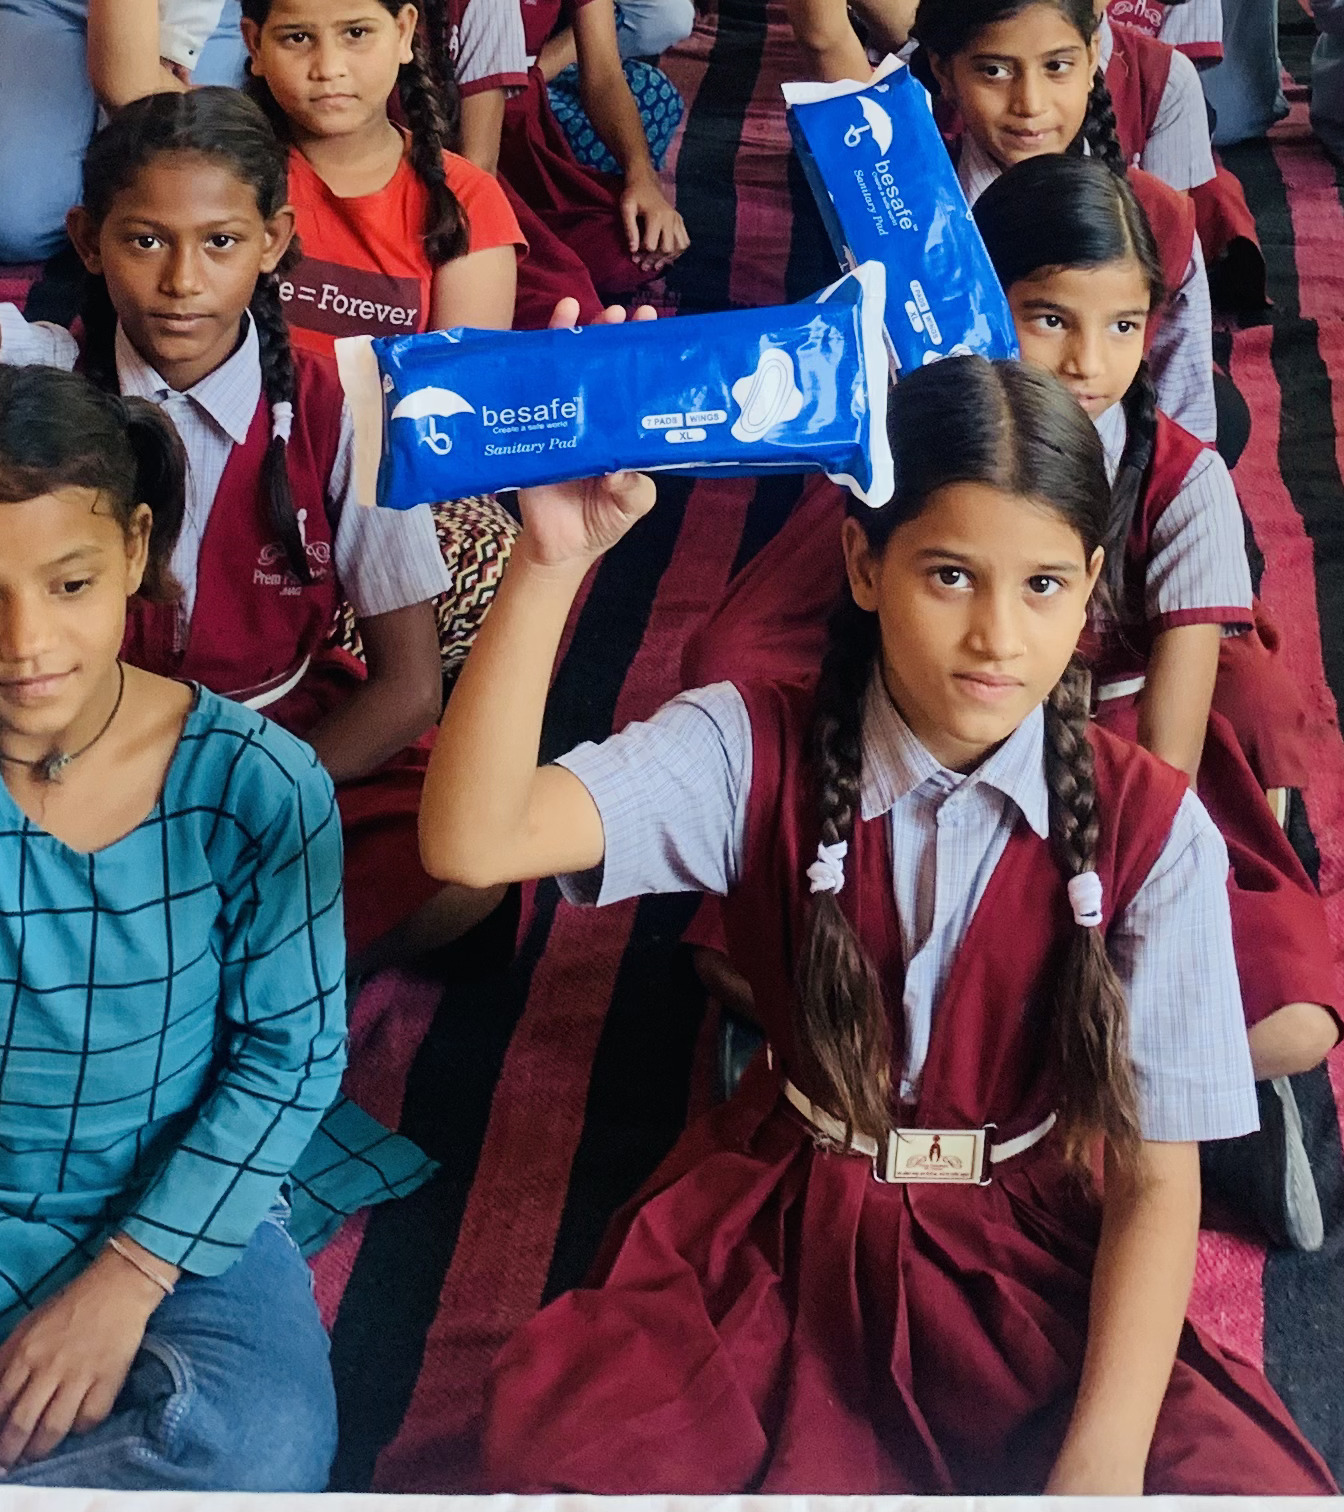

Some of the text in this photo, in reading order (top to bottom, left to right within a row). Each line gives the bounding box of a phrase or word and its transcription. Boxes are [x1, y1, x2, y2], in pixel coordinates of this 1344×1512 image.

[872, 215, 889, 236] Pad
[652, 416, 678, 426] PADS
[689, 413, 719, 423] WINGS
[678, 430, 693, 441] XL
[484, 436, 577, 457] Sanitary Pad
